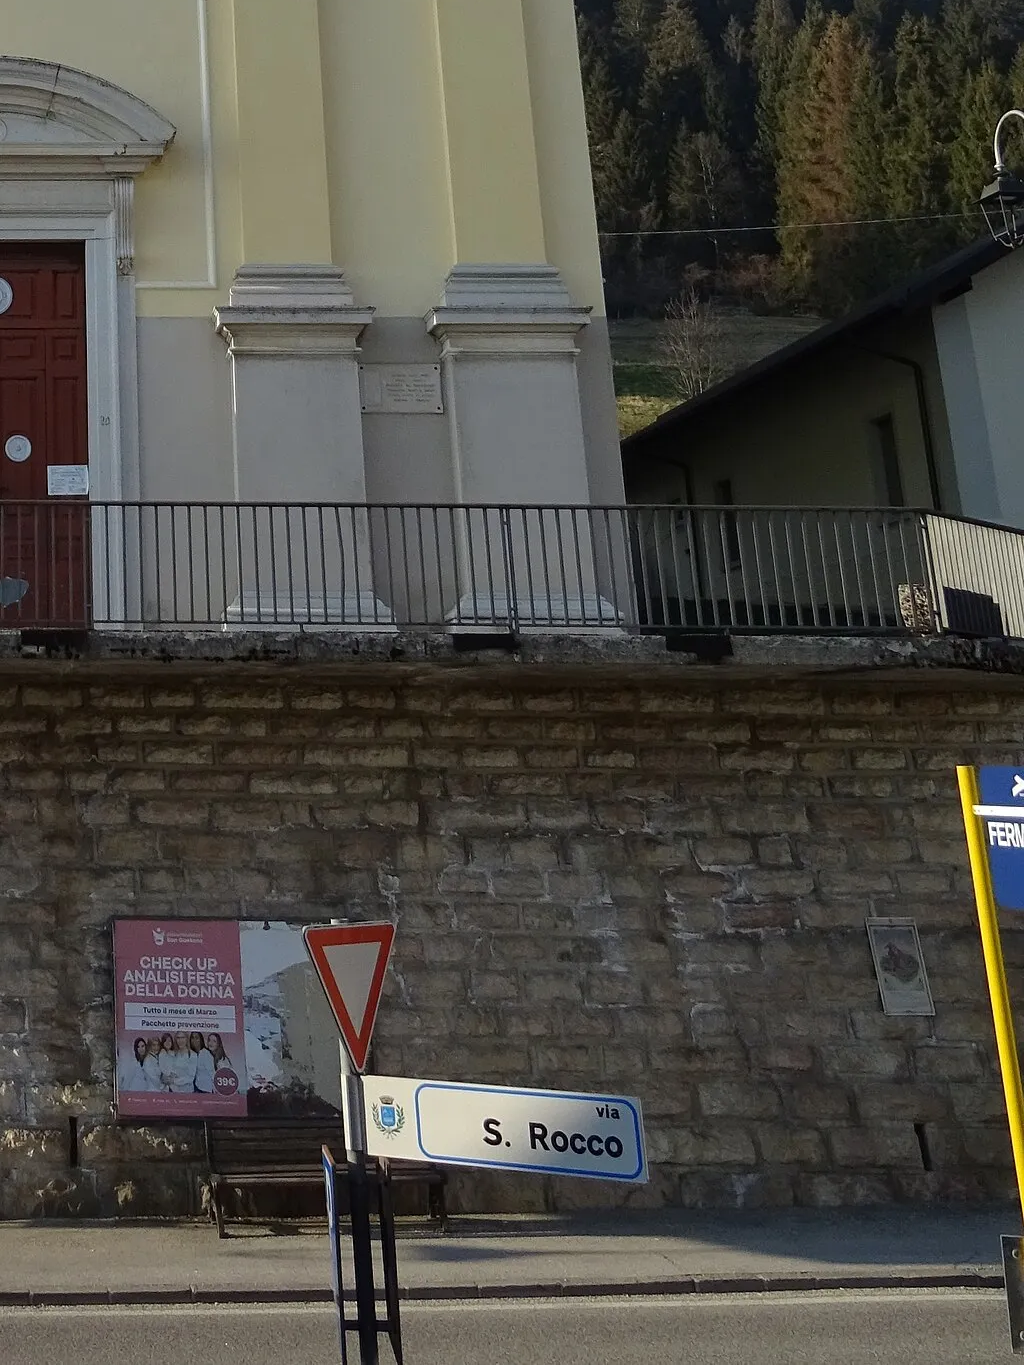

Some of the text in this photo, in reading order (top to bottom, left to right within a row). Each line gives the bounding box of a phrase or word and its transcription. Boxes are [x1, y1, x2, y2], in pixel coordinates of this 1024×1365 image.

[139, 956, 218, 971] CHECK UP
[123, 969, 236, 985] ANALISI FESTA
[125, 983, 235, 999] DELLA DONNA
[143, 1006, 162, 1015] Tutto
[162, 1006, 167, 1015] il
[187, 1007, 195, 1016] di
[195, 1008, 218, 1017] Marzo
[141, 1019, 220, 1031] Pacchetto prevenzione
[216, 1077, 236, 1087] 39€
[595, 1104, 621, 1120] via
[482, 1117, 624, 1159] S. Rocco
